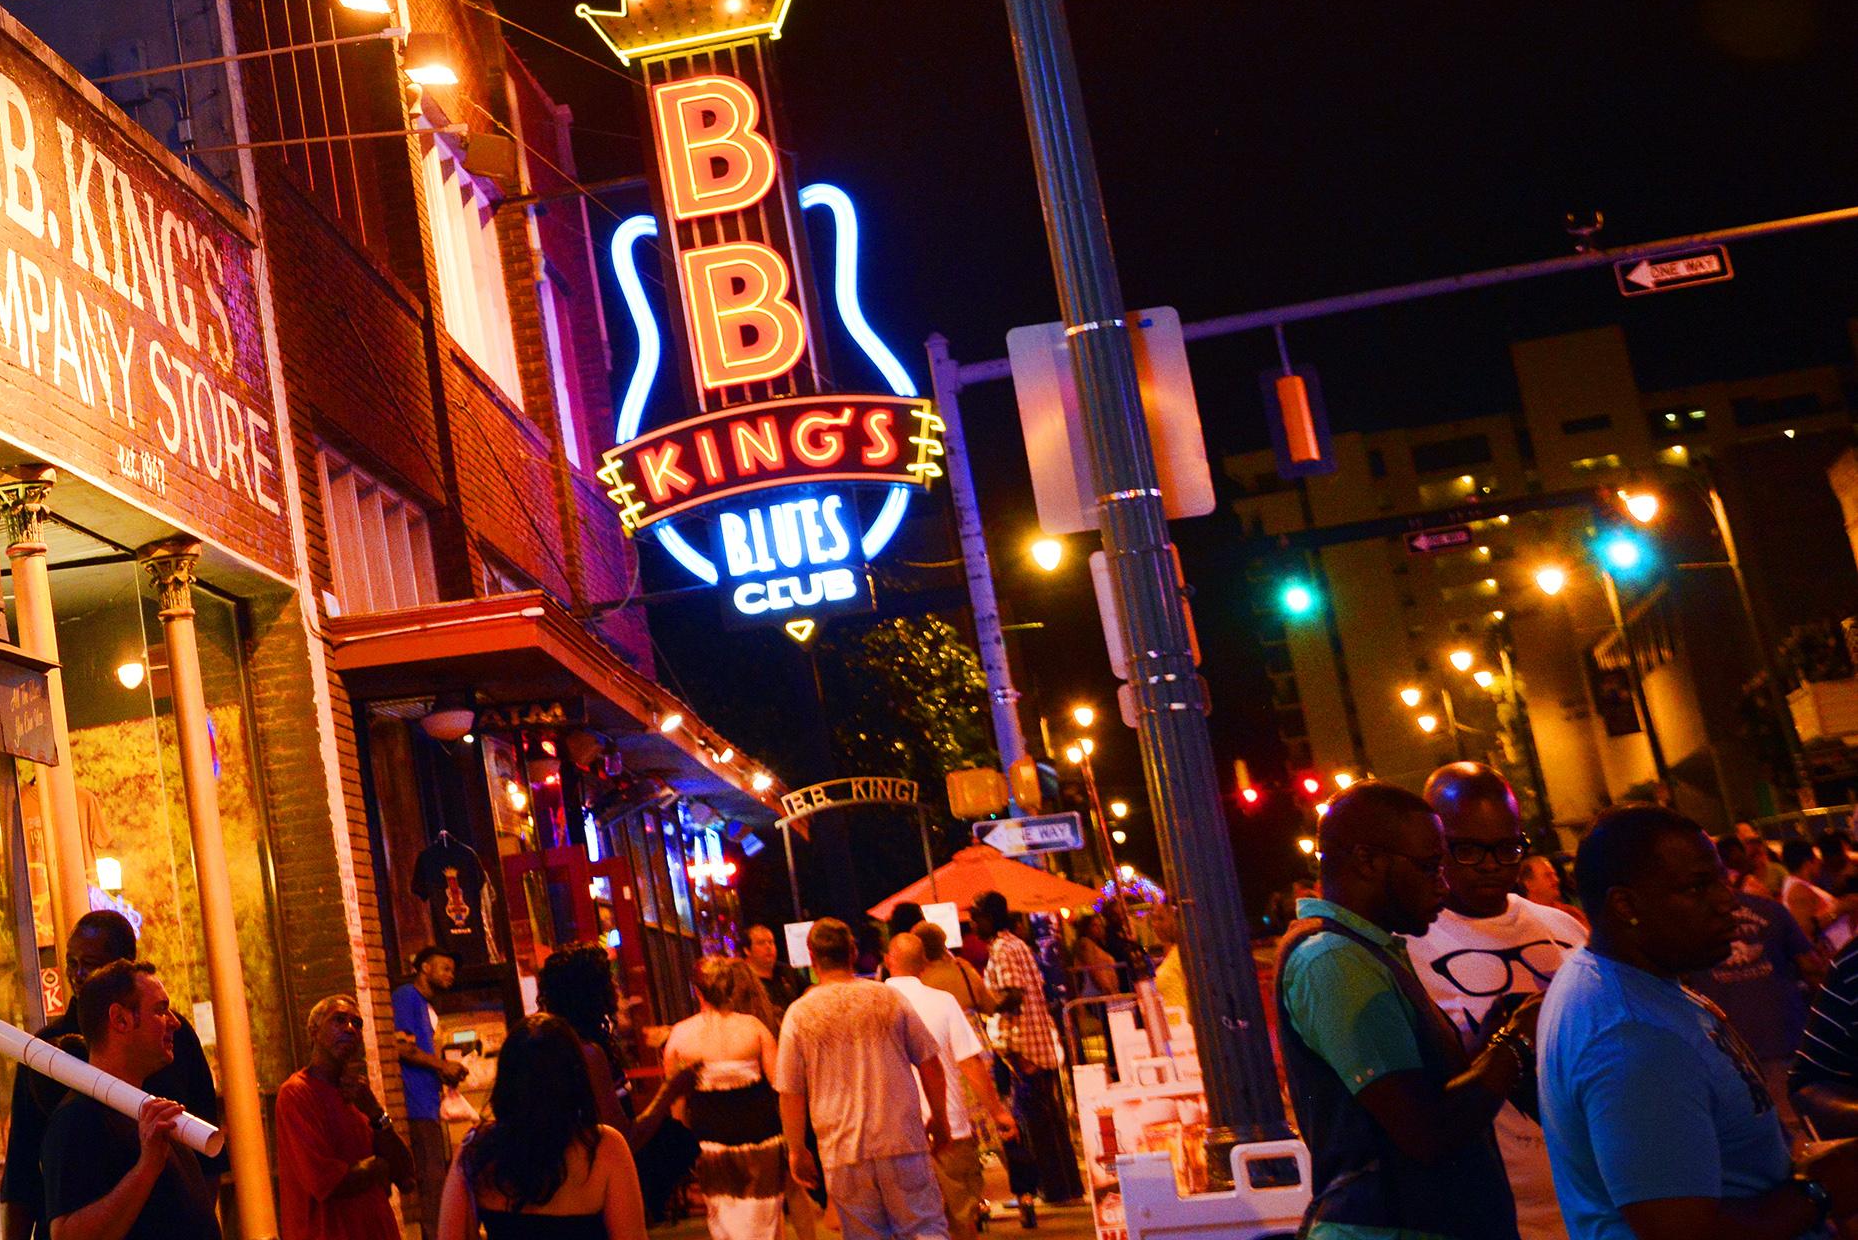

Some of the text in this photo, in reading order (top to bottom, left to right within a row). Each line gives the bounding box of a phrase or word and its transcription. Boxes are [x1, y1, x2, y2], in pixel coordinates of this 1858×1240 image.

[1650, 255, 1716, 279] ONE WAY
[149, 338, 280, 516] STORE
[636, 405, 899, 506] KING'S
[720, 492, 851, 578] BLUES
[733, 568, 856, 616] CLUB
[1040, 824, 1068, 841] WAY
